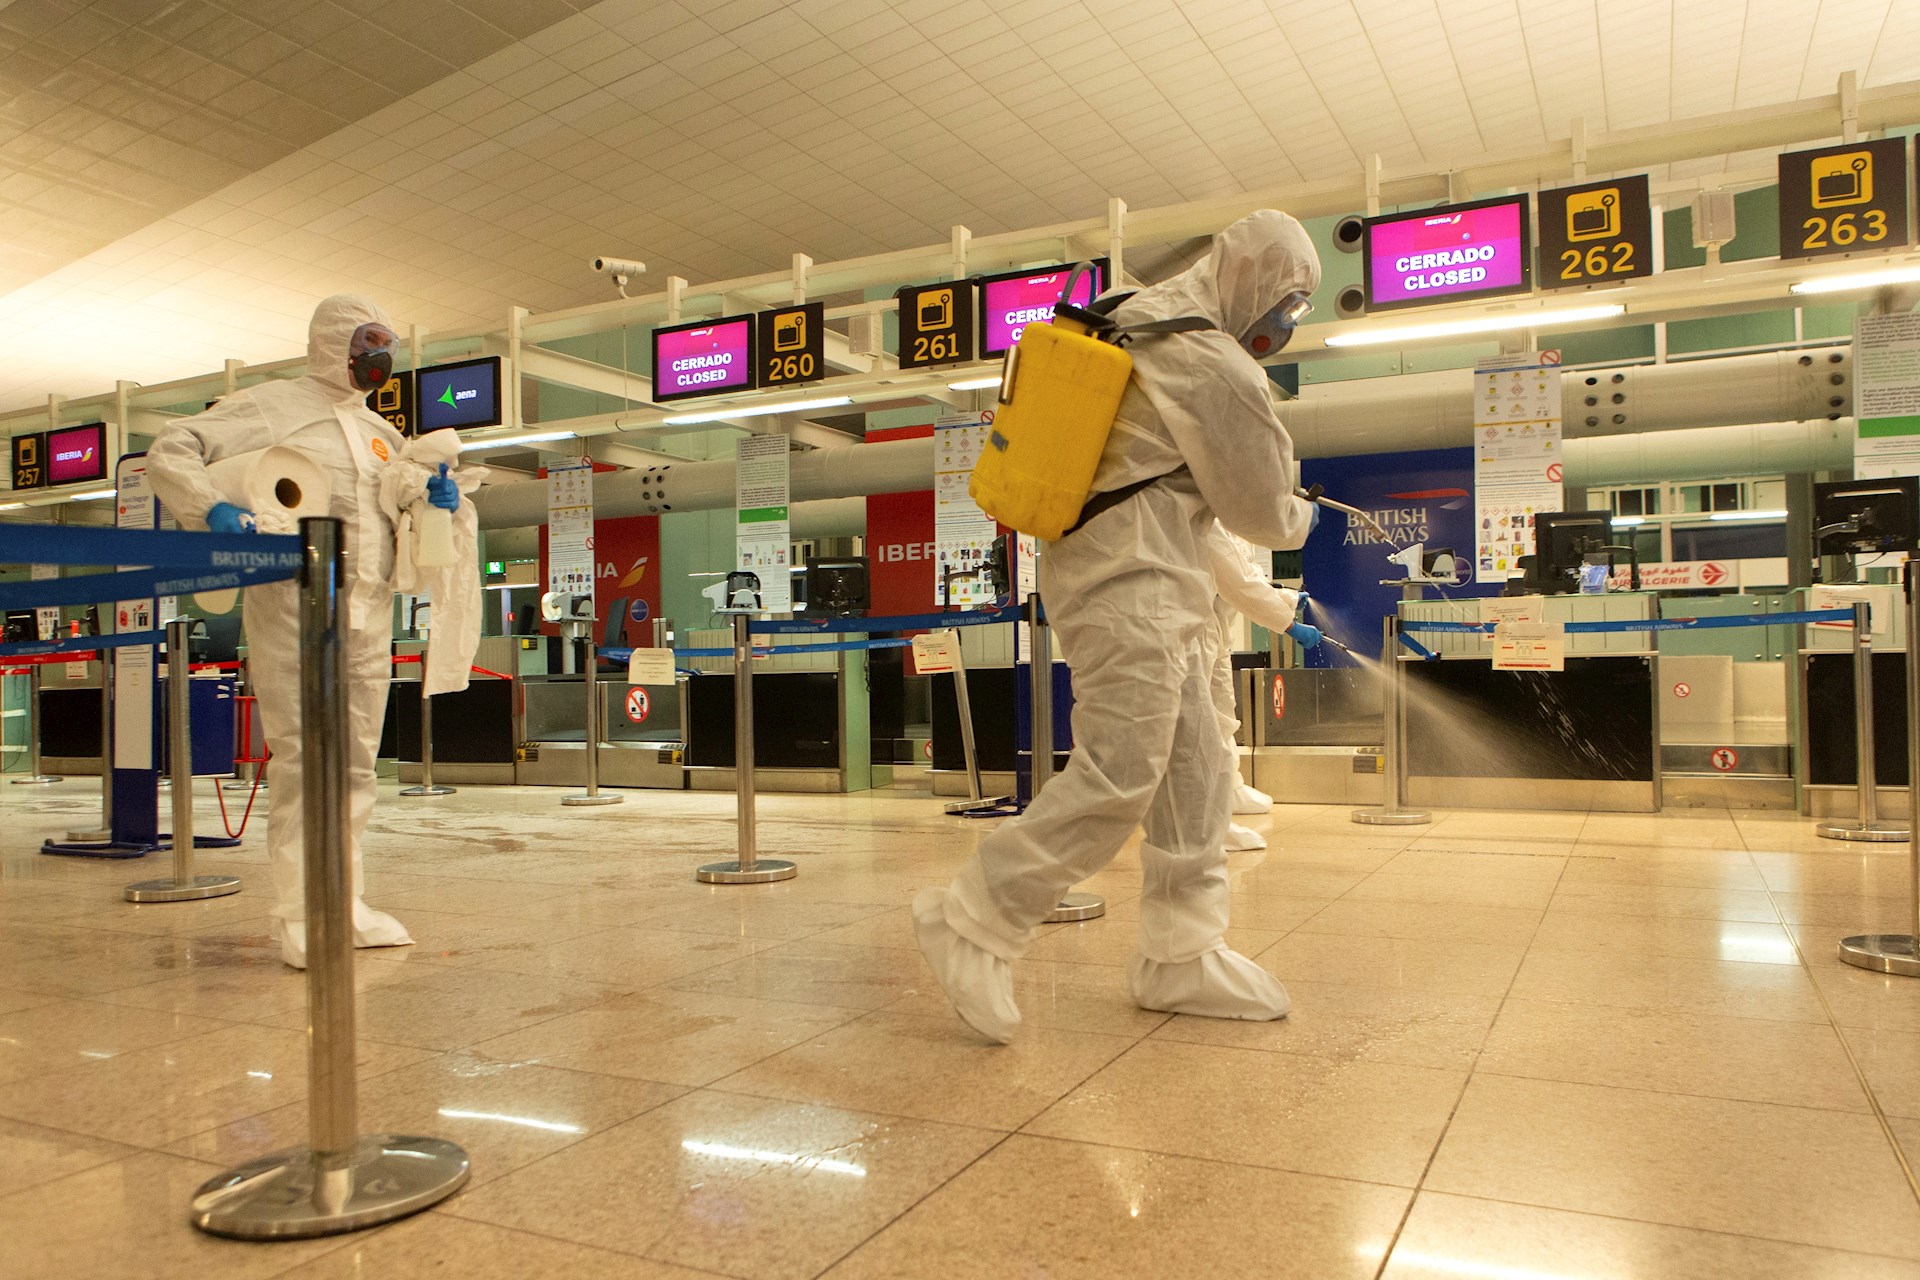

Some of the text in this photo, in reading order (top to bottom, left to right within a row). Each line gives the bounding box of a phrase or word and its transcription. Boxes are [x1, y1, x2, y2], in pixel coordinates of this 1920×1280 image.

[1424, 216, 1452, 226] IBERIA
[1802, 209, 1889, 250] 263
[1395, 244, 1496, 273] CERRADO
[1560, 242, 1635, 280] 262
[1028, 277, 1049, 285] IBERIA
[1403, 266, 1487, 291] CLOSED
[913, 332, 960, 362] 261
[672, 352, 733, 372] CERRADO
[768, 353, 815, 381] 260
[677, 369, 727, 387] CLOSED
[455, 388, 477, 400] aena
[386, 414, 406, 433] 59
[56, 450, 82, 462] IBERIA
[17, 467, 40, 487] 257
[1347, 507, 1427, 528] BRITISH
[1342, 525, 1430, 546] AIRWAYS
[211, 550, 275, 567] BRITISH
[878, 541, 936, 563] IBER
[154, 572, 240, 593] BRITISH AIRWAYS
